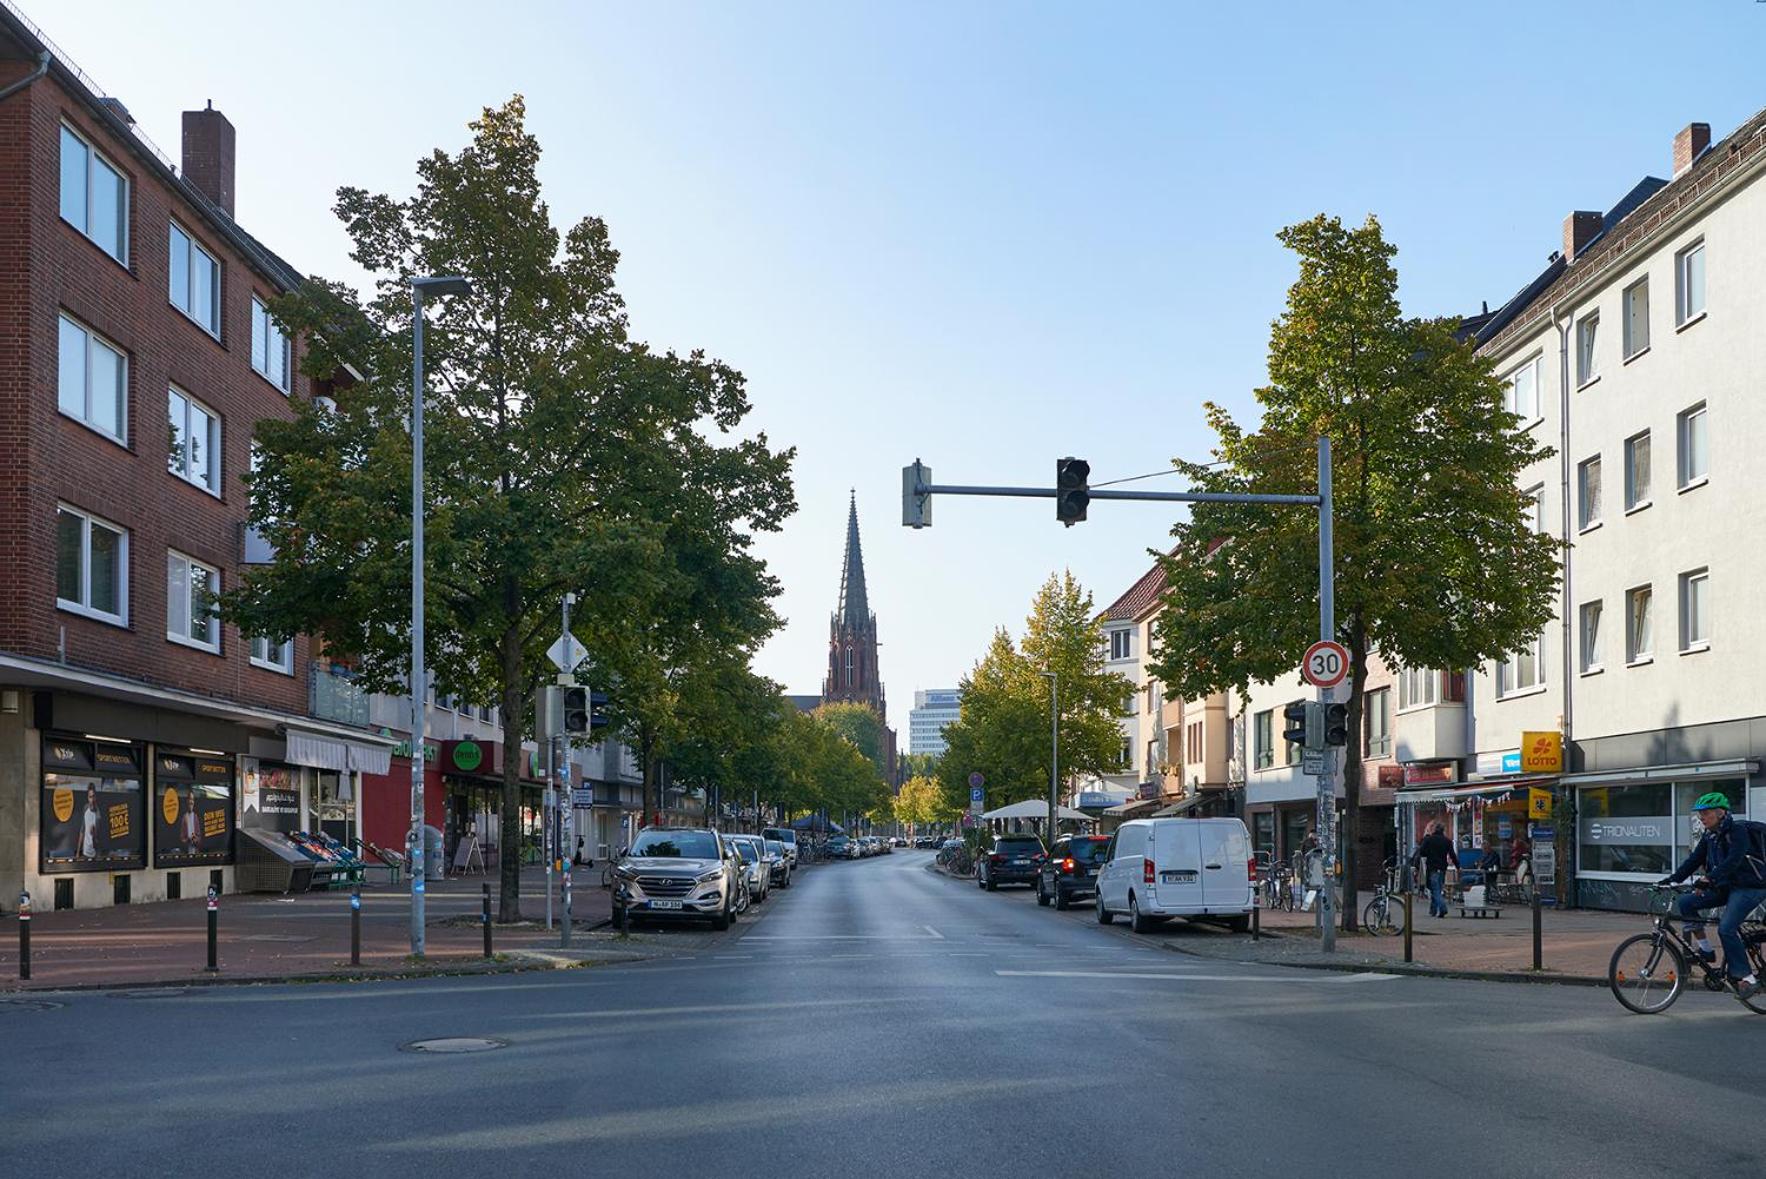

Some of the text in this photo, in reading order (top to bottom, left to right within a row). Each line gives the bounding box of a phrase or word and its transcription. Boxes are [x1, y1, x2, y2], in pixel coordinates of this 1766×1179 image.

[1312, 653, 1339, 675] 30
[1527, 757, 1557, 766] LOTTO
[973, 790, 981, 800] P
